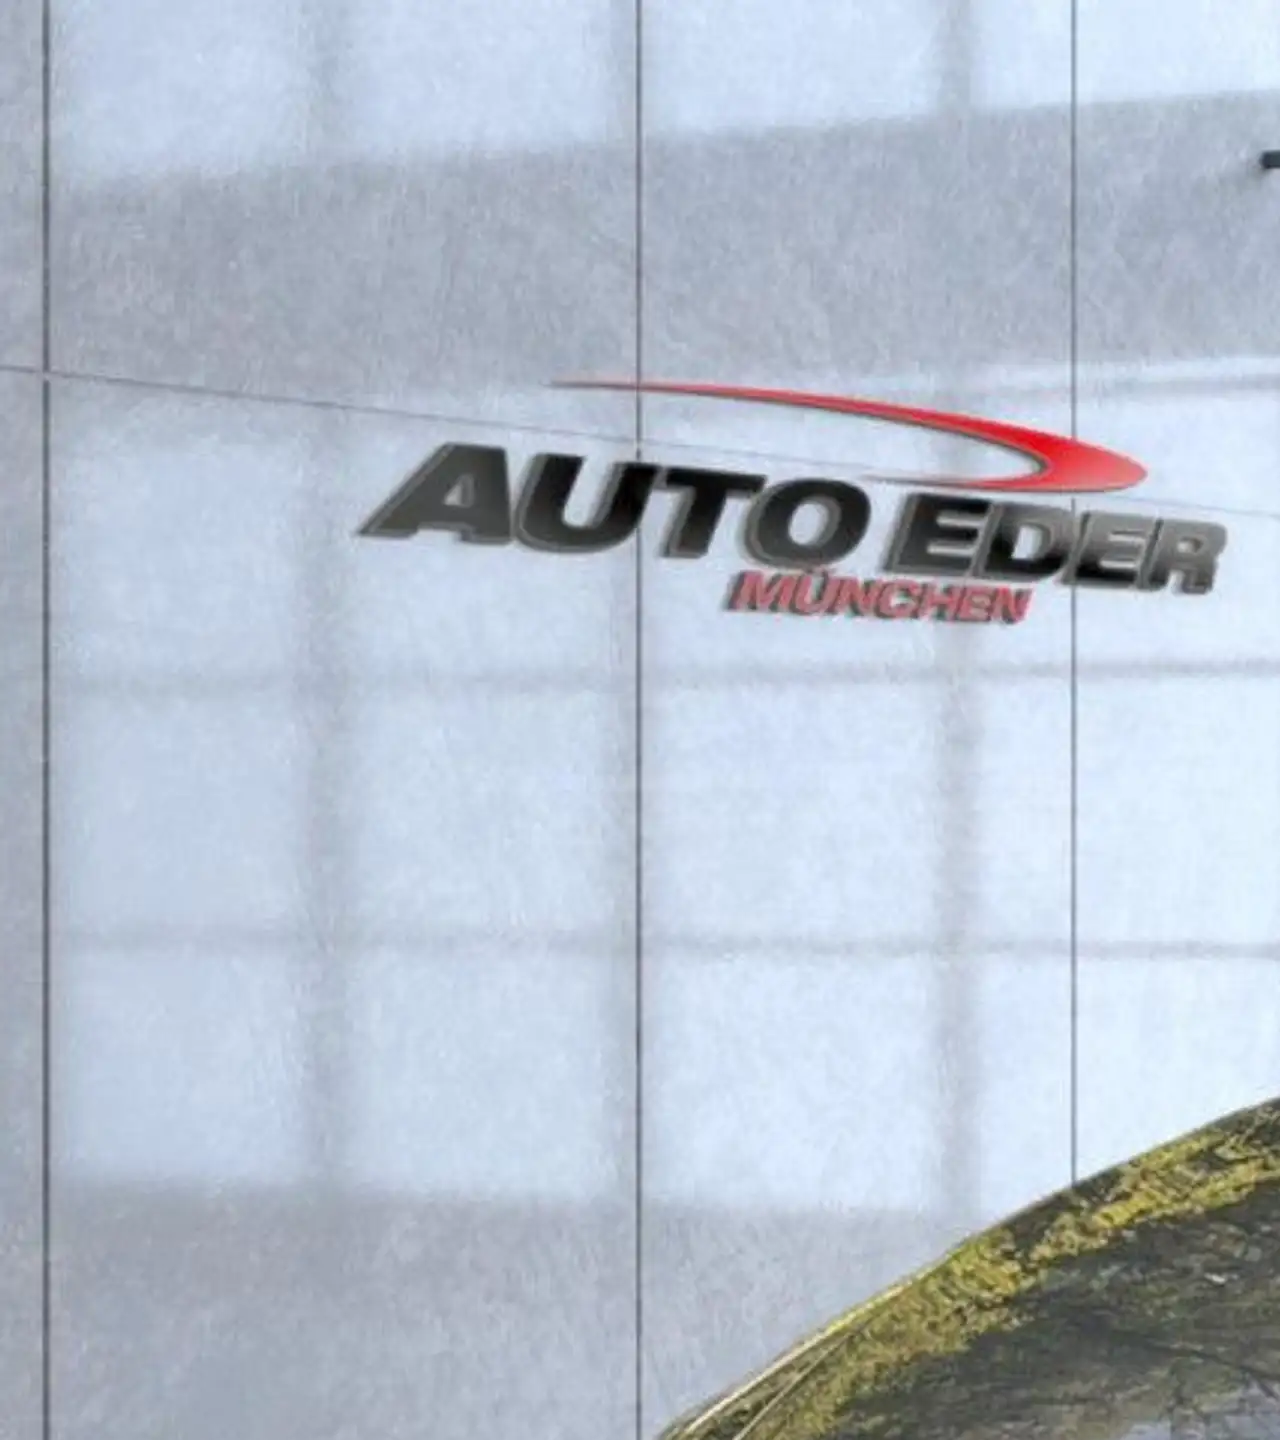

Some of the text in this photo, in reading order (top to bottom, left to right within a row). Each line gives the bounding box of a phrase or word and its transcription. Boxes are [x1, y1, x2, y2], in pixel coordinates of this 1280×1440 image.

[358, 442, 1230, 595] AUTO EDER
[725, 568, 1035, 625] MÜNCHEN
